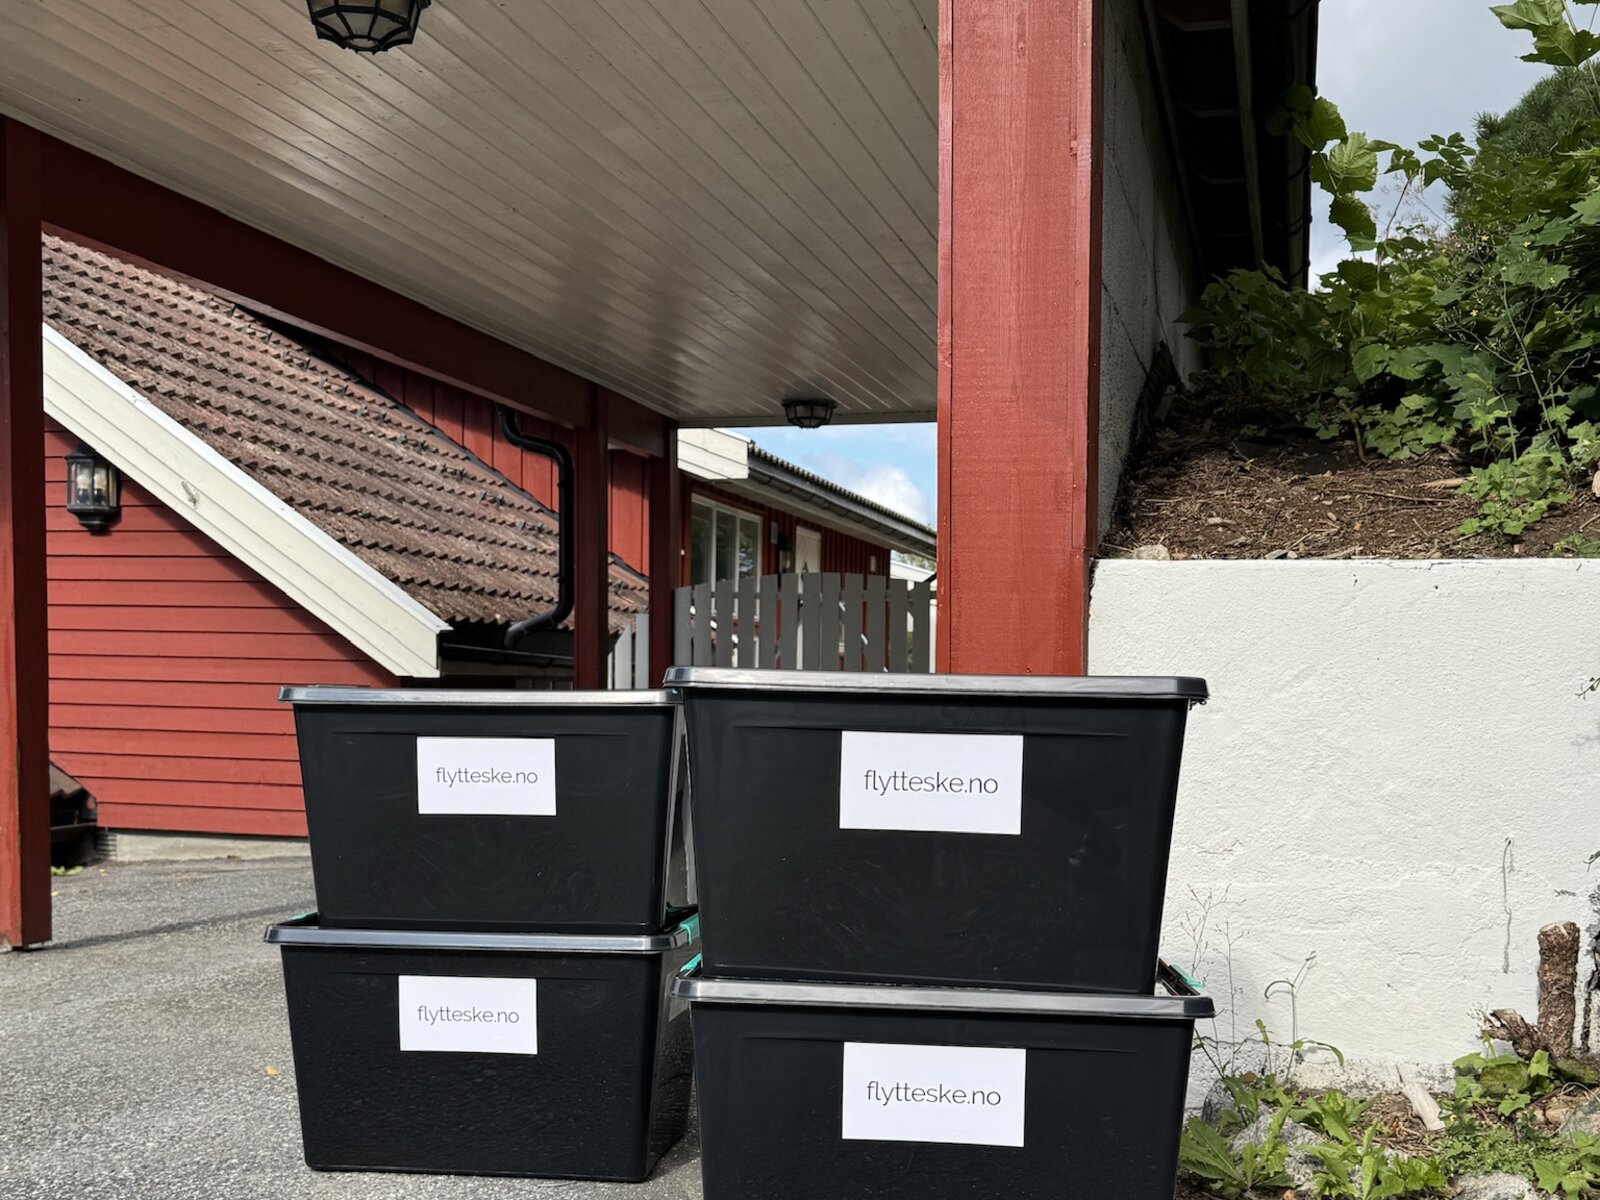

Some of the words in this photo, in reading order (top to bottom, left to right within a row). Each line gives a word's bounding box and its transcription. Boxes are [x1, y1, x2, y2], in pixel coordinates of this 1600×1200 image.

[436, 767, 538, 788] flytteske.no
[864, 769, 999, 797] flytteske.no
[418, 1005, 520, 1026] flytteske.no
[867, 1080, 1002, 1107] flytteske.no
